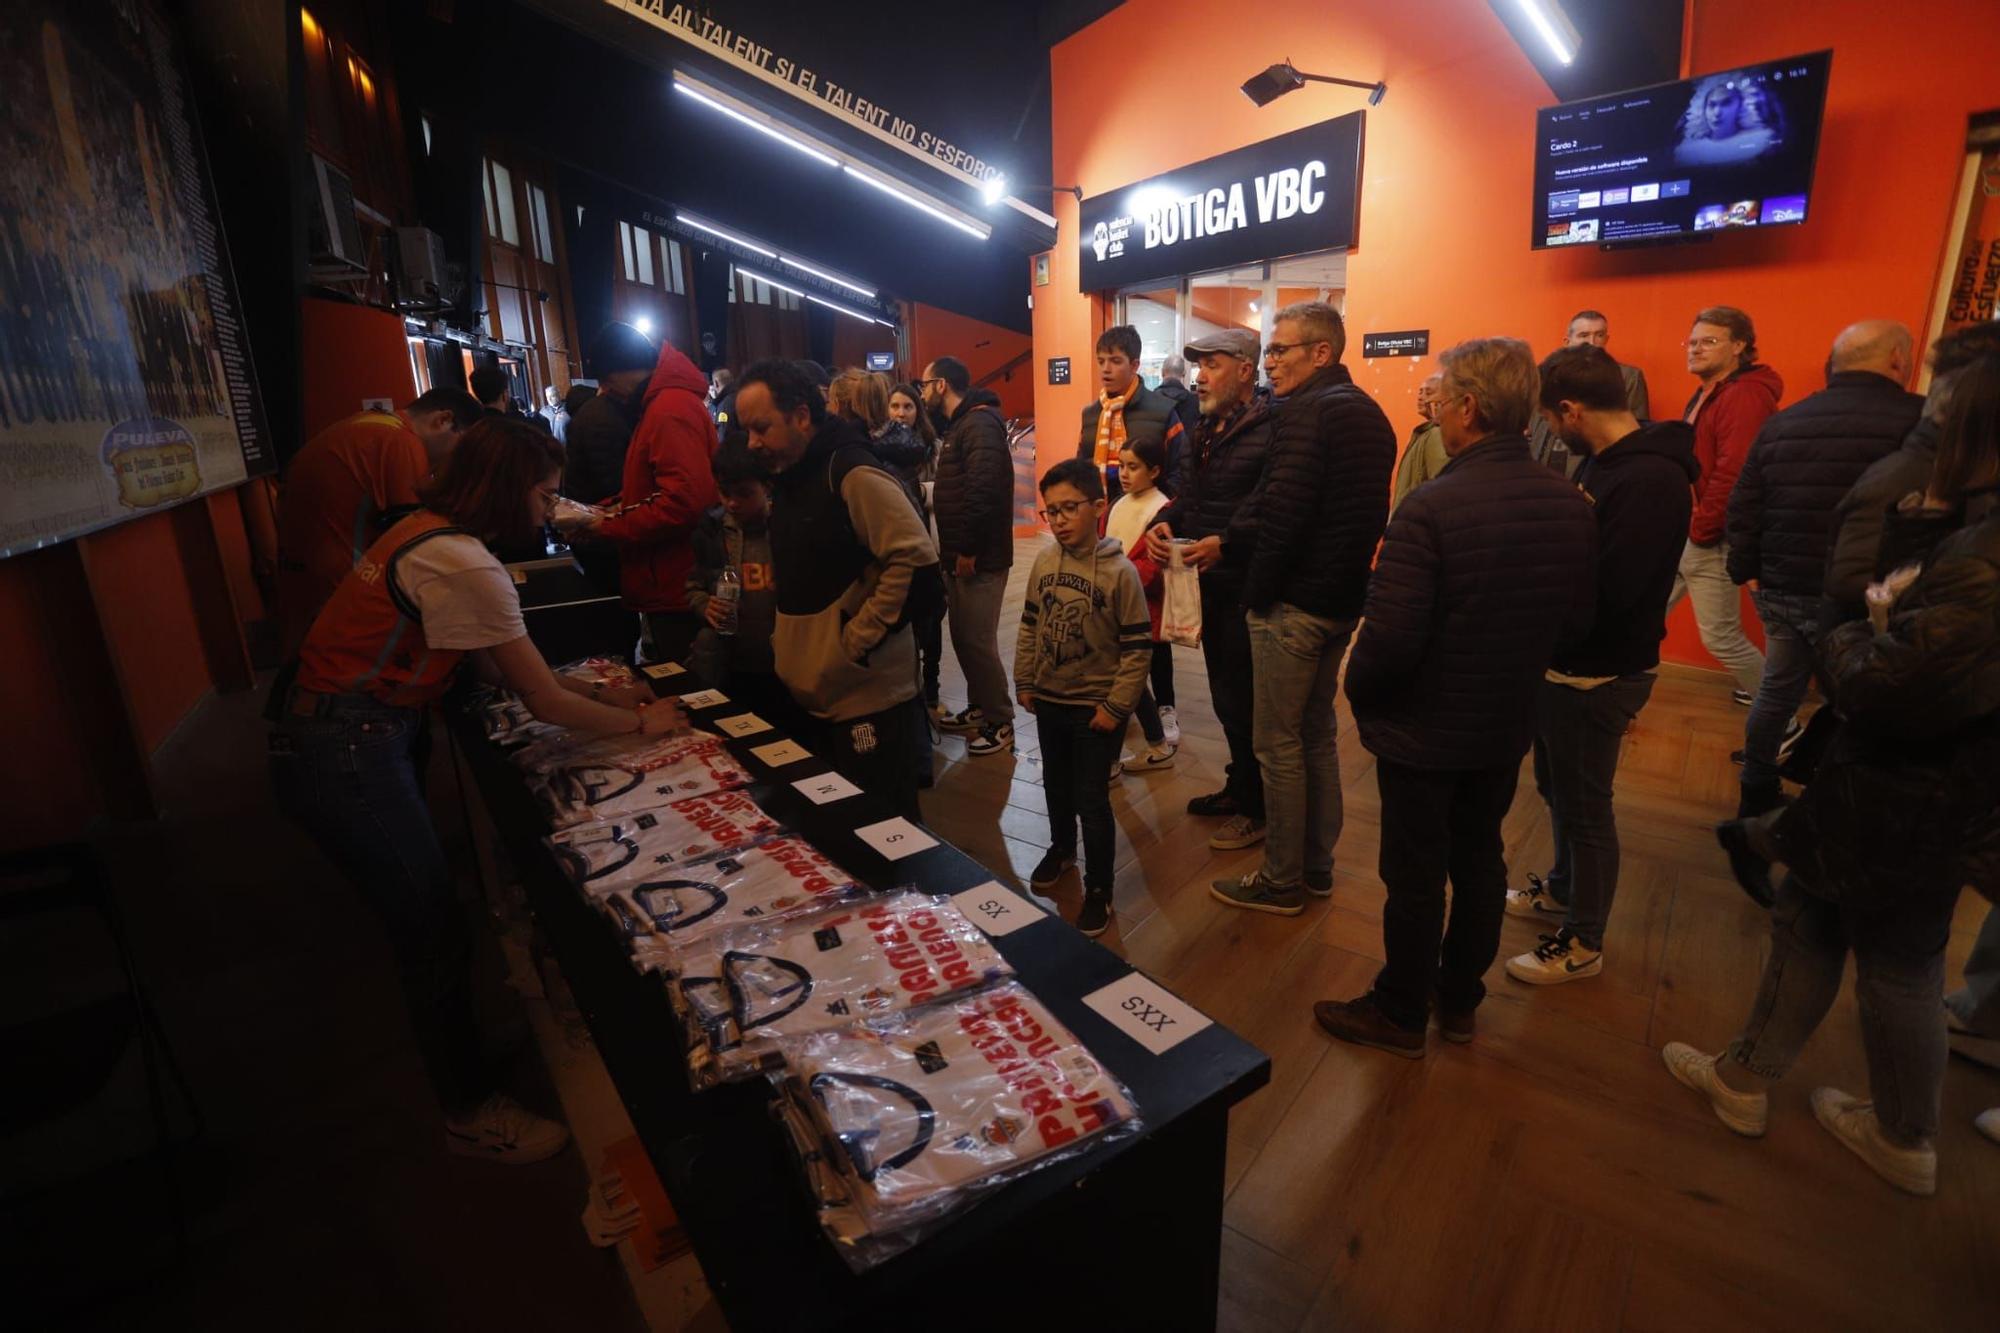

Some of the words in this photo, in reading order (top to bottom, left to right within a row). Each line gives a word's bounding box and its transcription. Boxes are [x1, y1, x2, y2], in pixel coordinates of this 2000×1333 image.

[668, 3, 694, 32] AL
[701, 17, 773, 70] TALENT
[774, 57, 796, 81] SI
[797, 69, 819, 96] EL
[825, 81, 890, 127] TALENT
[890, 116, 916, 143] NO
[1144, 183, 1248, 250] BOTIGA
[1255, 160, 1326, 223] VBC
[113, 430, 190, 447] PULEVA
[1038, 572, 1106, 609] HOGWAR
[817, 784, 837, 794] M
[886, 834, 904, 843] S
[978, 900, 1010, 919] XS
[1121, 996, 1177, 1032] XXS
